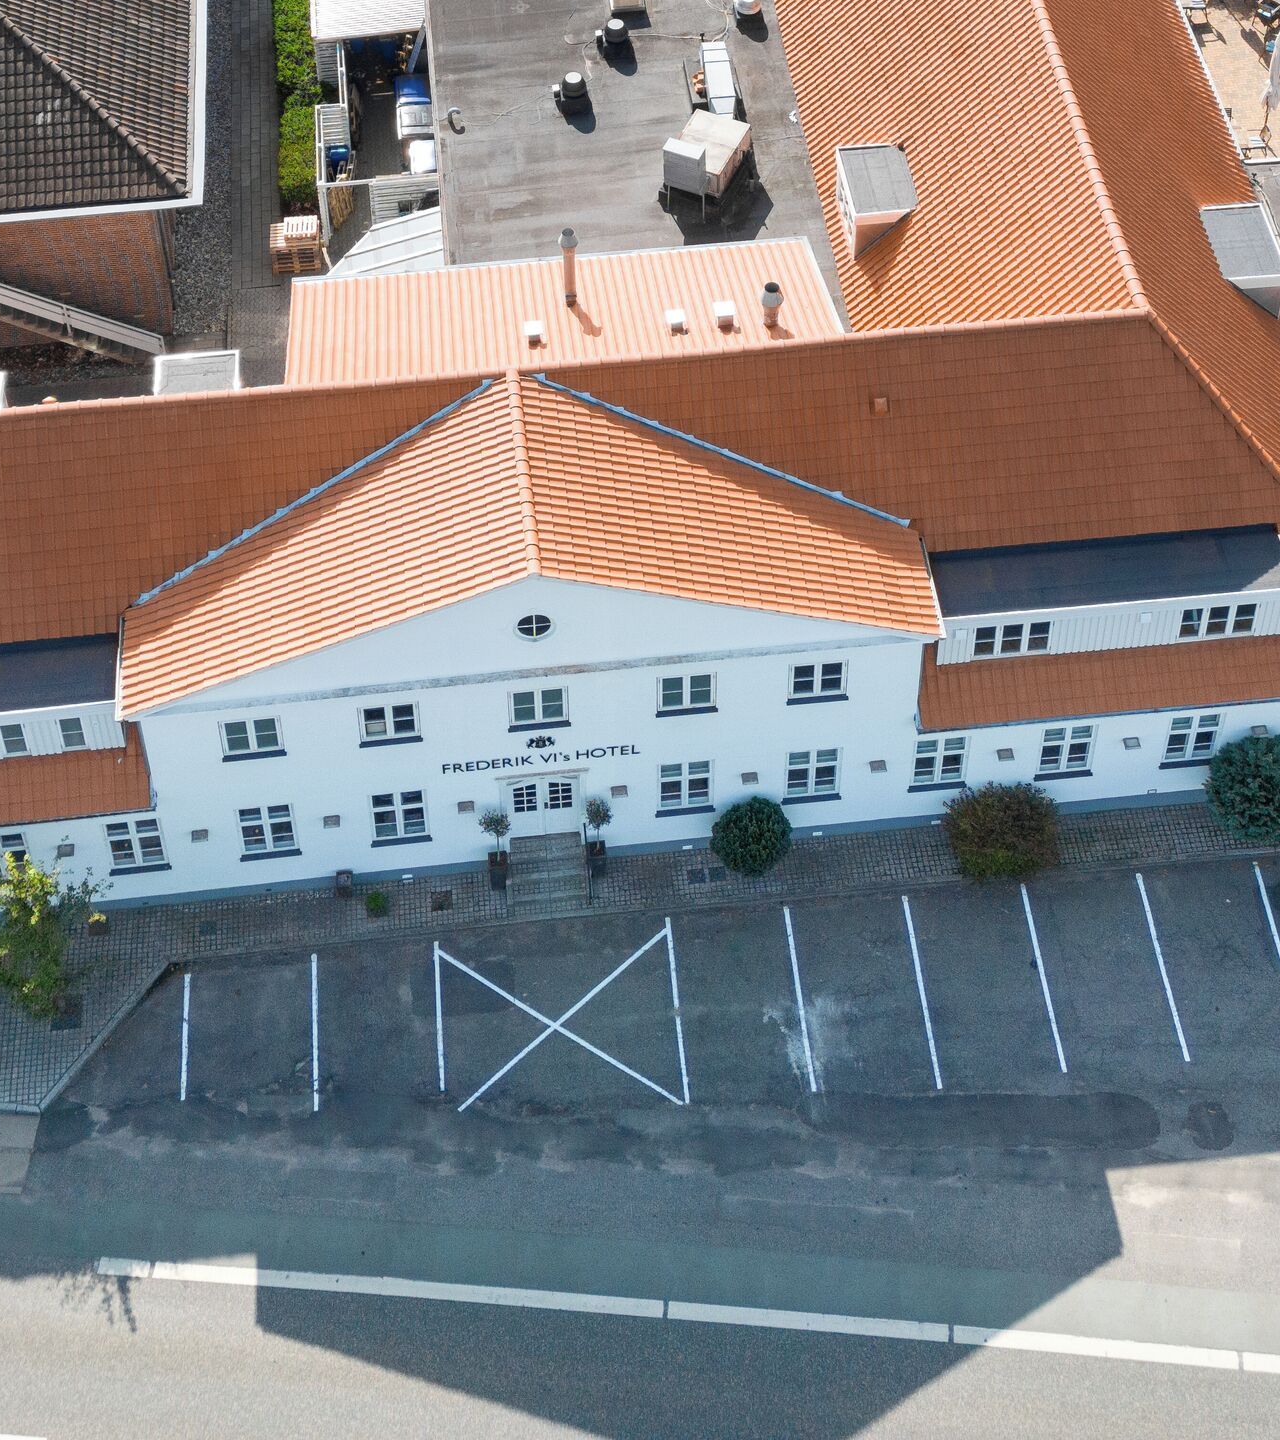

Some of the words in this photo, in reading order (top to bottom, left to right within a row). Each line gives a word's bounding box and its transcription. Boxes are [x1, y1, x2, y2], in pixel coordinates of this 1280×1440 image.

[441, 755, 534, 774] FREDERIK
[539, 751, 571, 764] VI's
[575, 744, 641, 760] HOTEL
